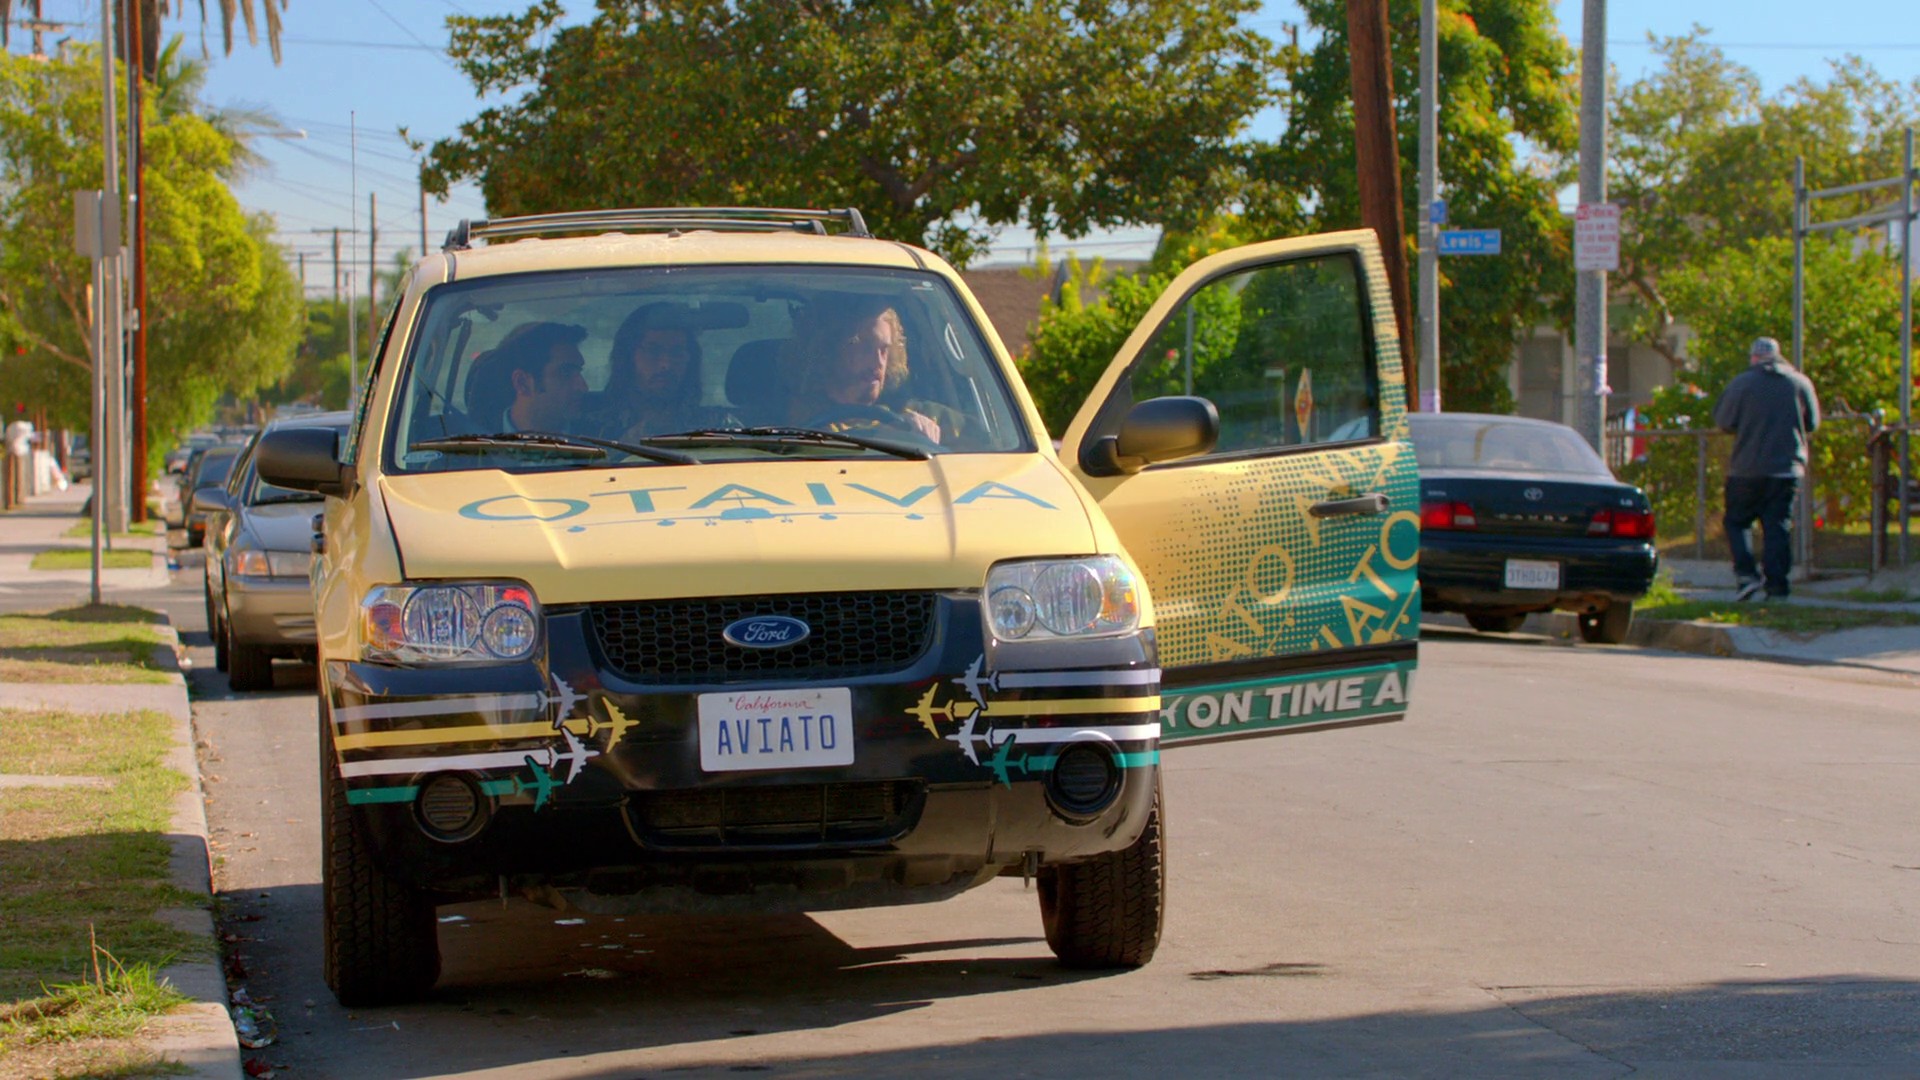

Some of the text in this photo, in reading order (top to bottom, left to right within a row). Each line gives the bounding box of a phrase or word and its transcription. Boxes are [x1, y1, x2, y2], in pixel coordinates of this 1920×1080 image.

[1441, 233, 1482, 249] Lewis
[744, 621, 790, 642] Ford
[735, 695, 815, 714] California
[1187, 690, 1253, 729] ON
[1265, 676, 1365, 720] TIME
[717, 714, 836, 756] AVIATO
